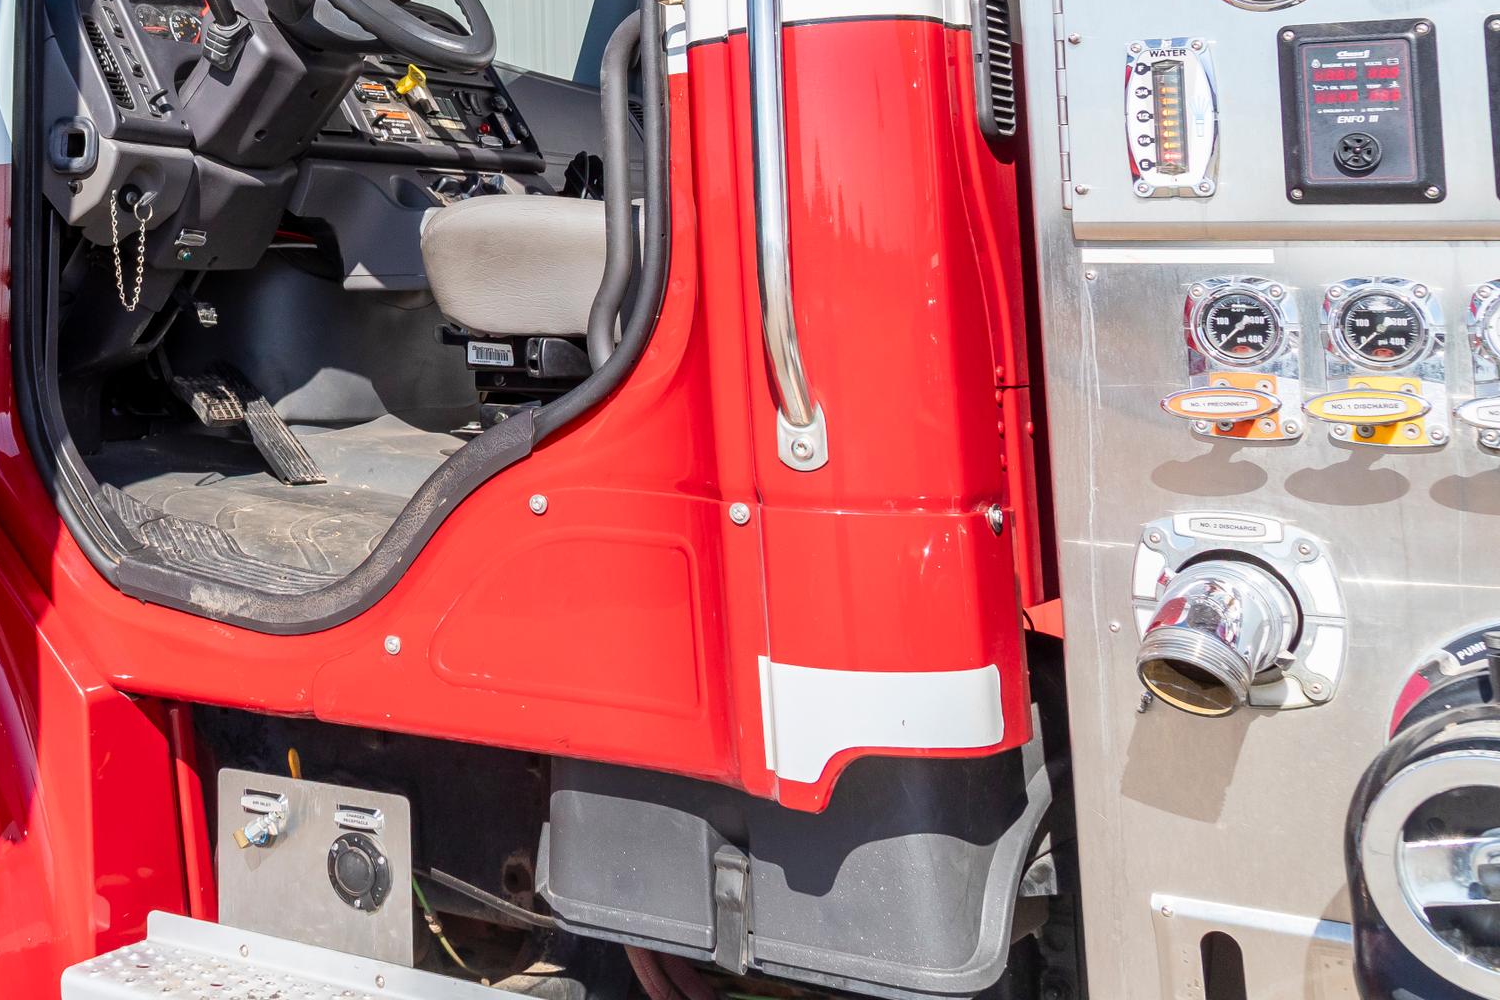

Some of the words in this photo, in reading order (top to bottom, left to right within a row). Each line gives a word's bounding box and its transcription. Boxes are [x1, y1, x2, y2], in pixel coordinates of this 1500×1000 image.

[1149, 49, 1187, 58] WATER
[1337, 115, 1365, 124] ENFO
[1216, 317, 1229, 325] 100
[1248, 335, 1263, 343] 400
[343, 818, 369, 826] RECEPTACLE
